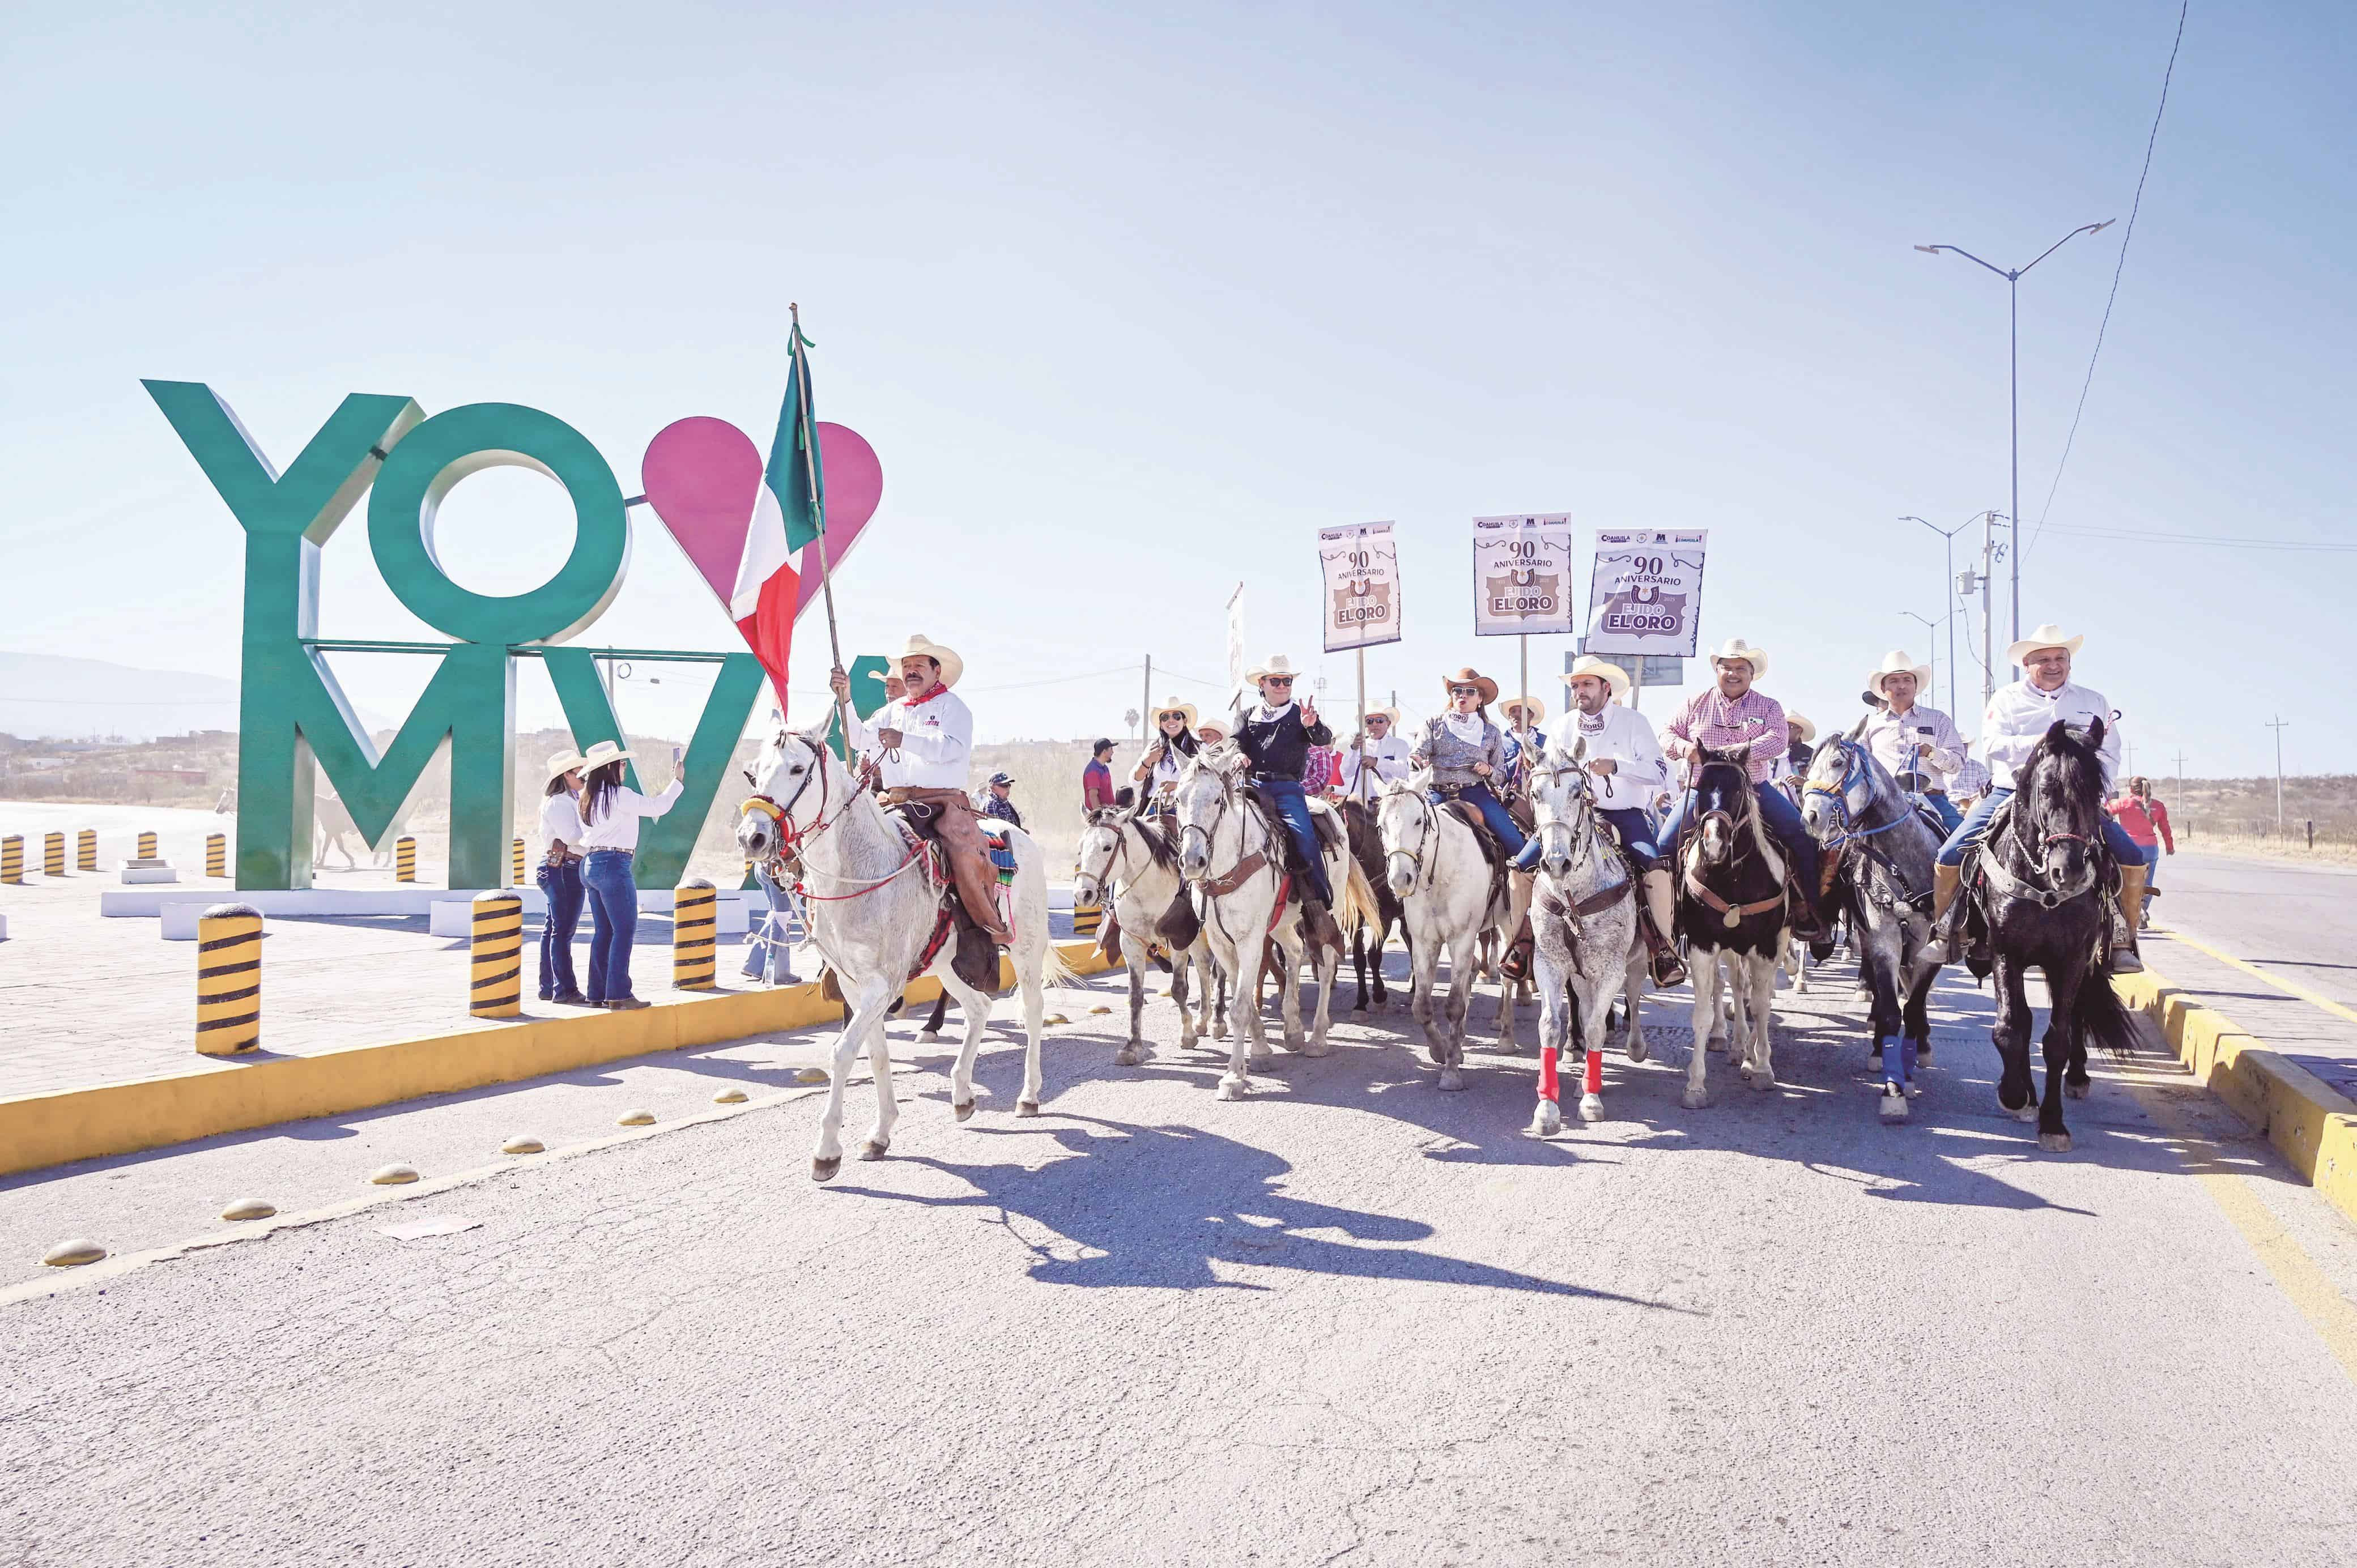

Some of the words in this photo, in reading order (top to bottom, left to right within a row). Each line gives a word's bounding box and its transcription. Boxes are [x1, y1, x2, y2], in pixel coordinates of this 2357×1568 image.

[140, 379, 632, 646] YO
[1509, 541, 1535, 559] 90
[1348, 551, 1369, 569] 90
[1494, 559, 1552, 568] ANIVERSARIO
[1634, 557, 1663, 575] 90
[1338, 569, 1384, 581] ANIVERSARIO
[1614, 575, 1681, 586] ANIVERSARIO
[1505, 586, 1542, 597] EJIDO
[1346, 595, 1377, 608] EJIDO
[1495, 598, 1514, 611] EL
[1516, 596, 1552, 610] ORO
[1339, 610, 1354, 623] EL
[1355, 606, 1385, 620] ORO
[1622, 603, 1665, 616] EJIDO
[1609, 615, 1630, 628] EL
[1633, 615, 1676, 630] ORO
